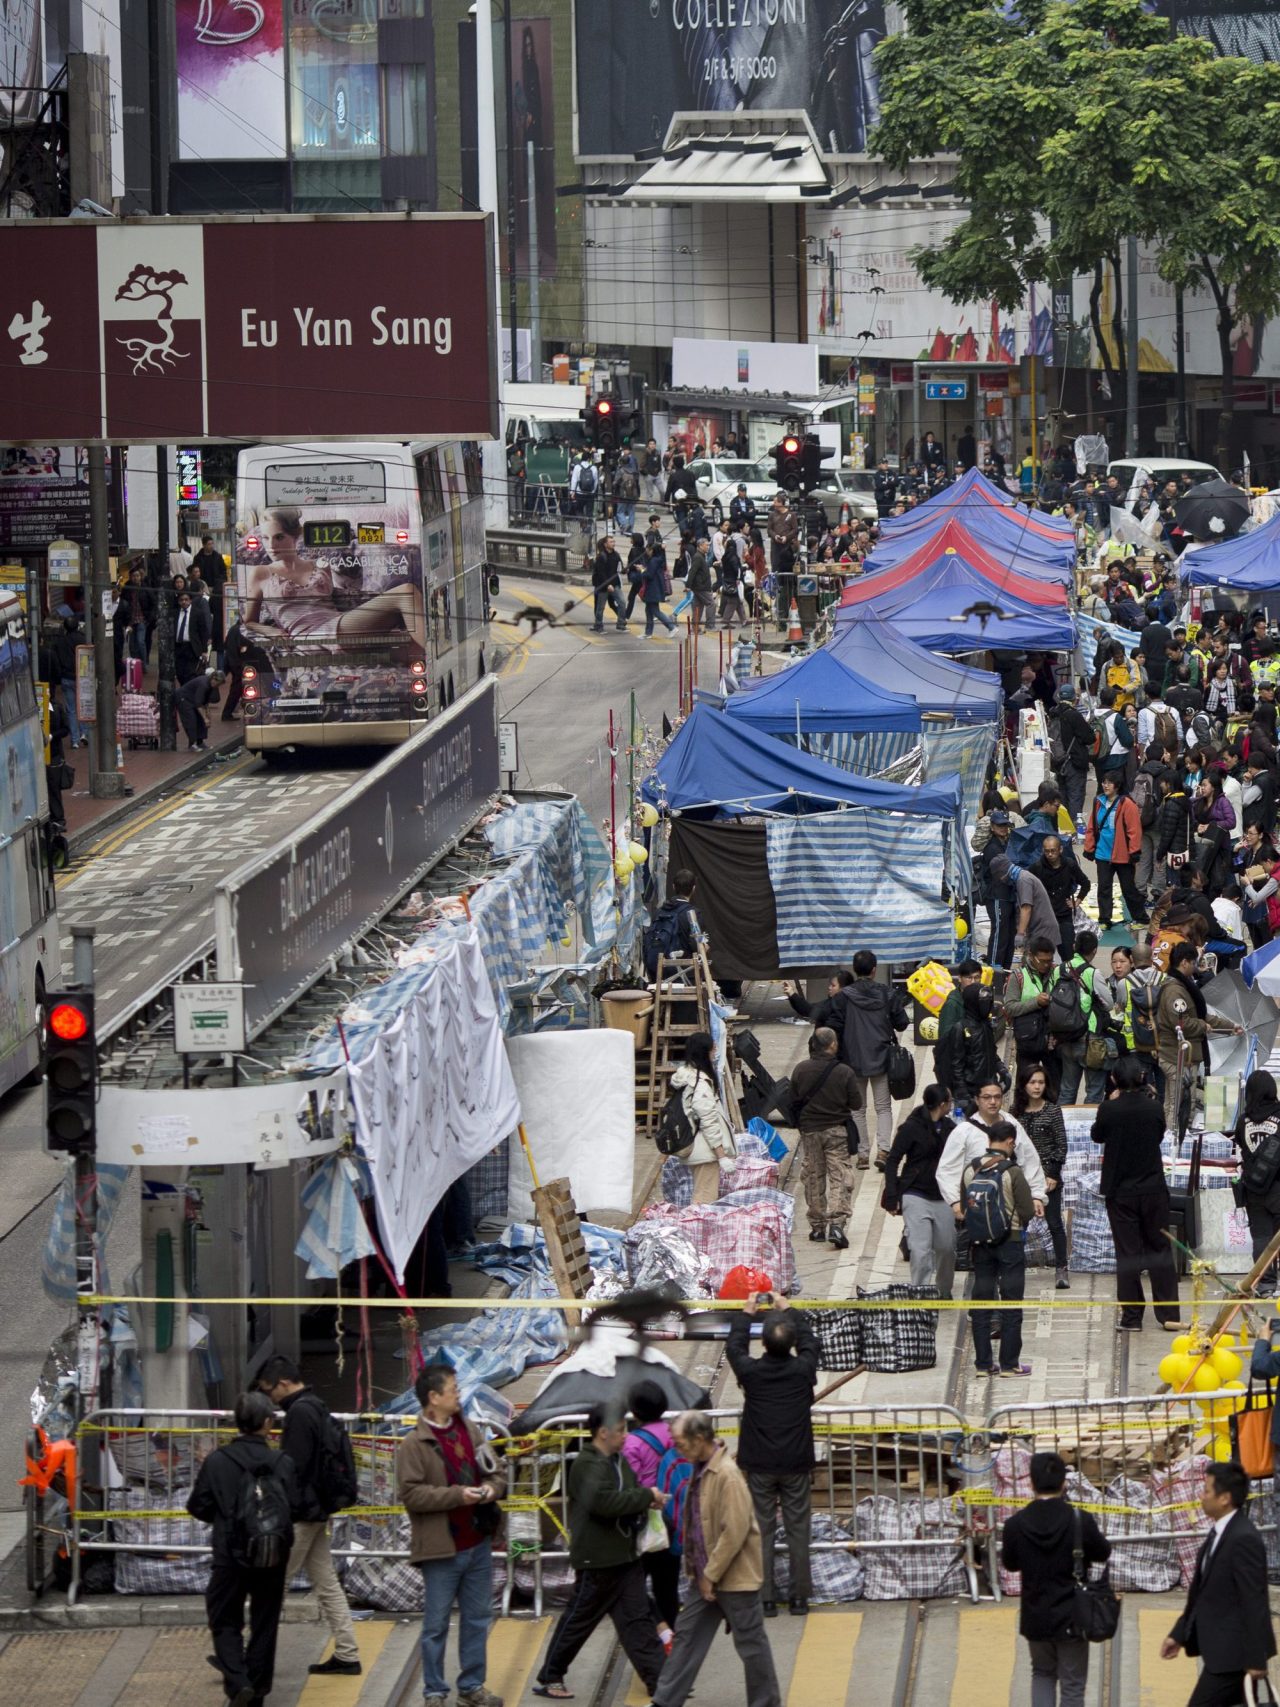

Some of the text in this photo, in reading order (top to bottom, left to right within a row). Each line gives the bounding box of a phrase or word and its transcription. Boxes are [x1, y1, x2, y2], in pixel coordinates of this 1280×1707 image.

[704, 56, 777, 85] 2/F & 5/F SOGO
[7, 300, 52, 365] 生
[241, 306, 452, 355] Eu Yan Sang
[313, 527, 344, 544] 112
[361, 534, 384, 543] 8821
[329, 554, 409, 568] CASABLANCA
[218, 771, 360, 788] BUS
[182, 784, 352, 801] STOP
[160, 798, 311, 821] 巴士
[118, 835, 271, 855] BUS
